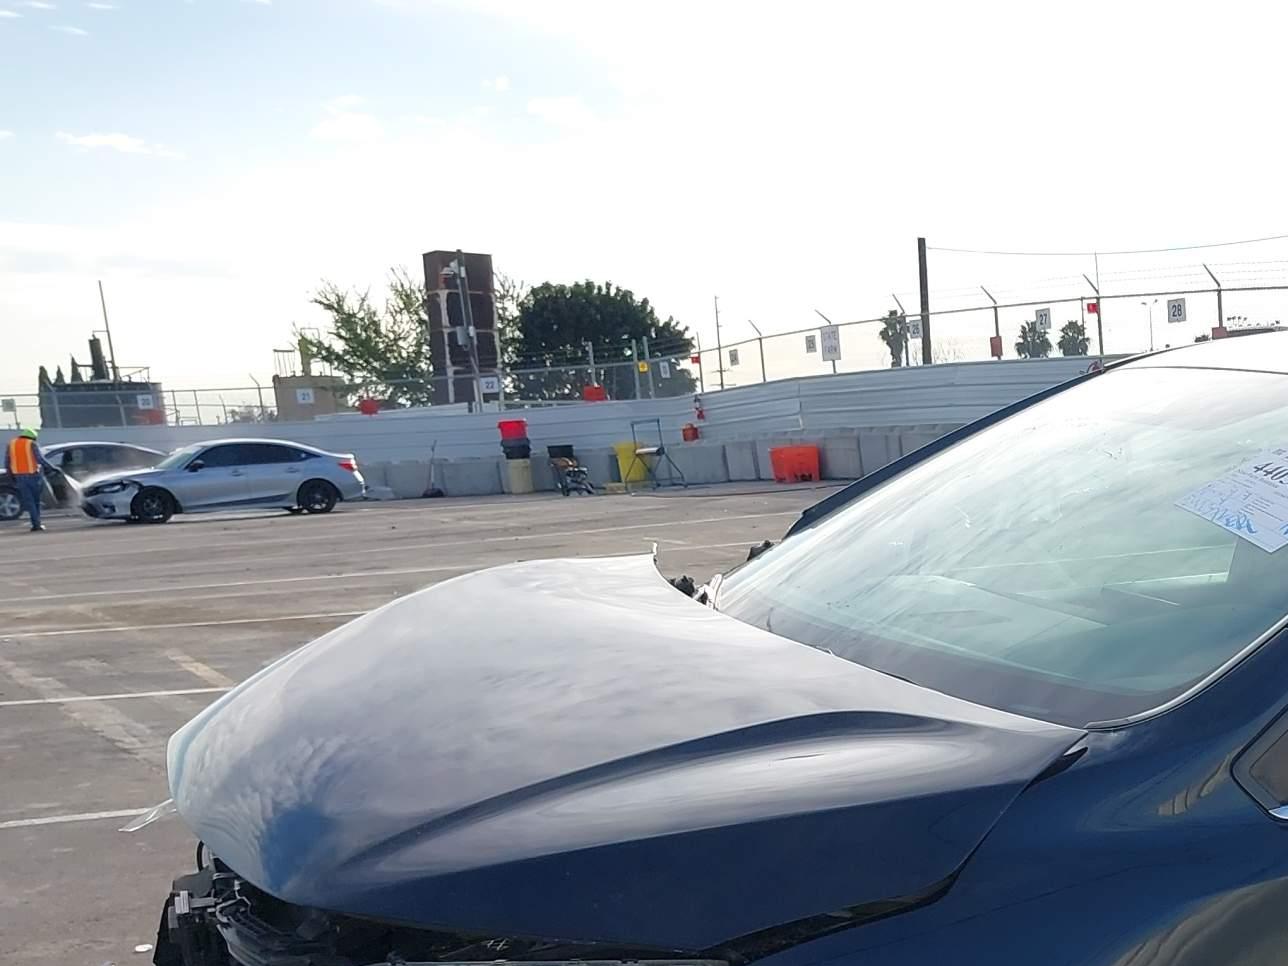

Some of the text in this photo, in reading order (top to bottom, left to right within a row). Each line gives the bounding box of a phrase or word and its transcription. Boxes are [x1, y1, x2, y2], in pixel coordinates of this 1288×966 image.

[1172, 303, 1182, 317] 28
[1039, 313, 1048, 326] 27
[484, 381, 495, 390] 22
